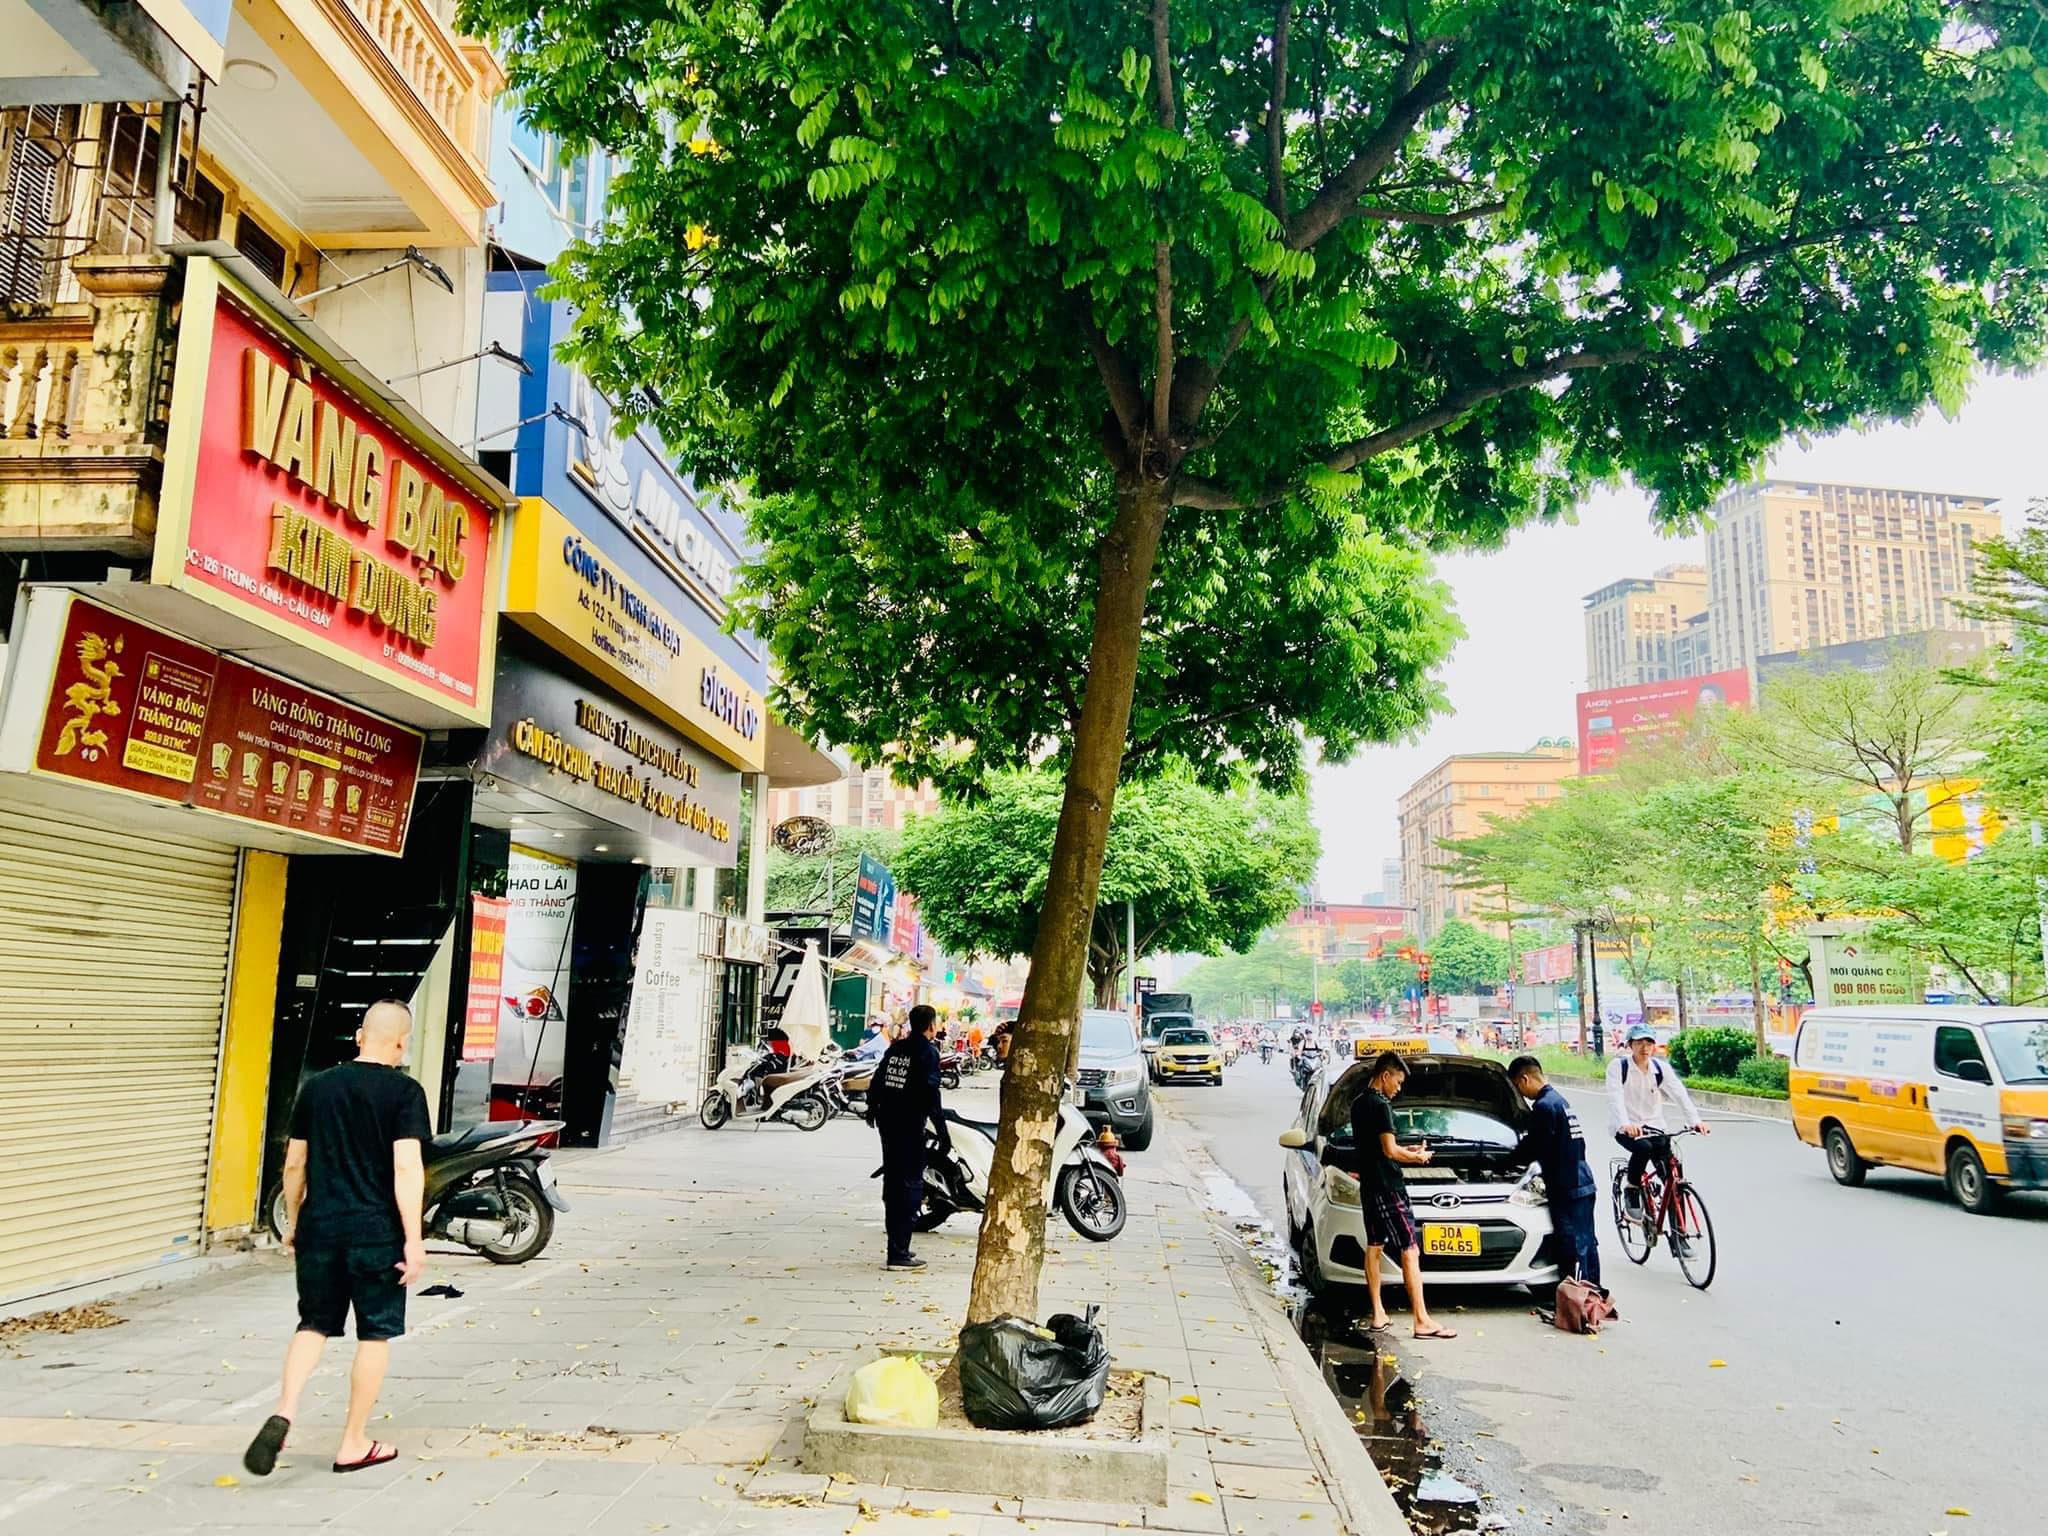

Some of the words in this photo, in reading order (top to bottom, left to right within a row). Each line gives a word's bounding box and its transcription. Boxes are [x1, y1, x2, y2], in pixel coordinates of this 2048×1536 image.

[241, 347, 385, 530] VÀNG
[388, 459, 471, 582] BẠC
[267, 501, 352, 602] KIM
[203, 554, 219, 575] 126
[221, 563, 258, 594] TRUNG
[601, 567, 618, 602] TY
[592, 599, 605, 623] 122
[143, 685, 174, 709] VÀNG
[175, 694, 206, 719] RỒNG
[700, 665, 735, 726] ĐÍCH
[138, 705, 174, 728] THĂNG
[174, 717, 201, 737] LONG
[252, 687, 289, 716] VÀNG
[289, 697, 325, 728] RỒNG
[325, 714, 364, 743] THĂNG
[363, 730, 393, 753] LONG
[576, 699, 617, 743] TRUNG
[511, 717, 544, 760] CÂN
[595, 760, 622, 796] THAY
[544, 875, 568, 890] LÁI
[653, 922, 665, 968] Espresso
[645, 969, 681, 988] Coffee
[1833, 983, 1854, 994] 090
[1856, 983, 1877, 994] 806
[1431, 1239, 1473, 1252] 684.65
[1439, 1226, 1463, 1239] 30A
